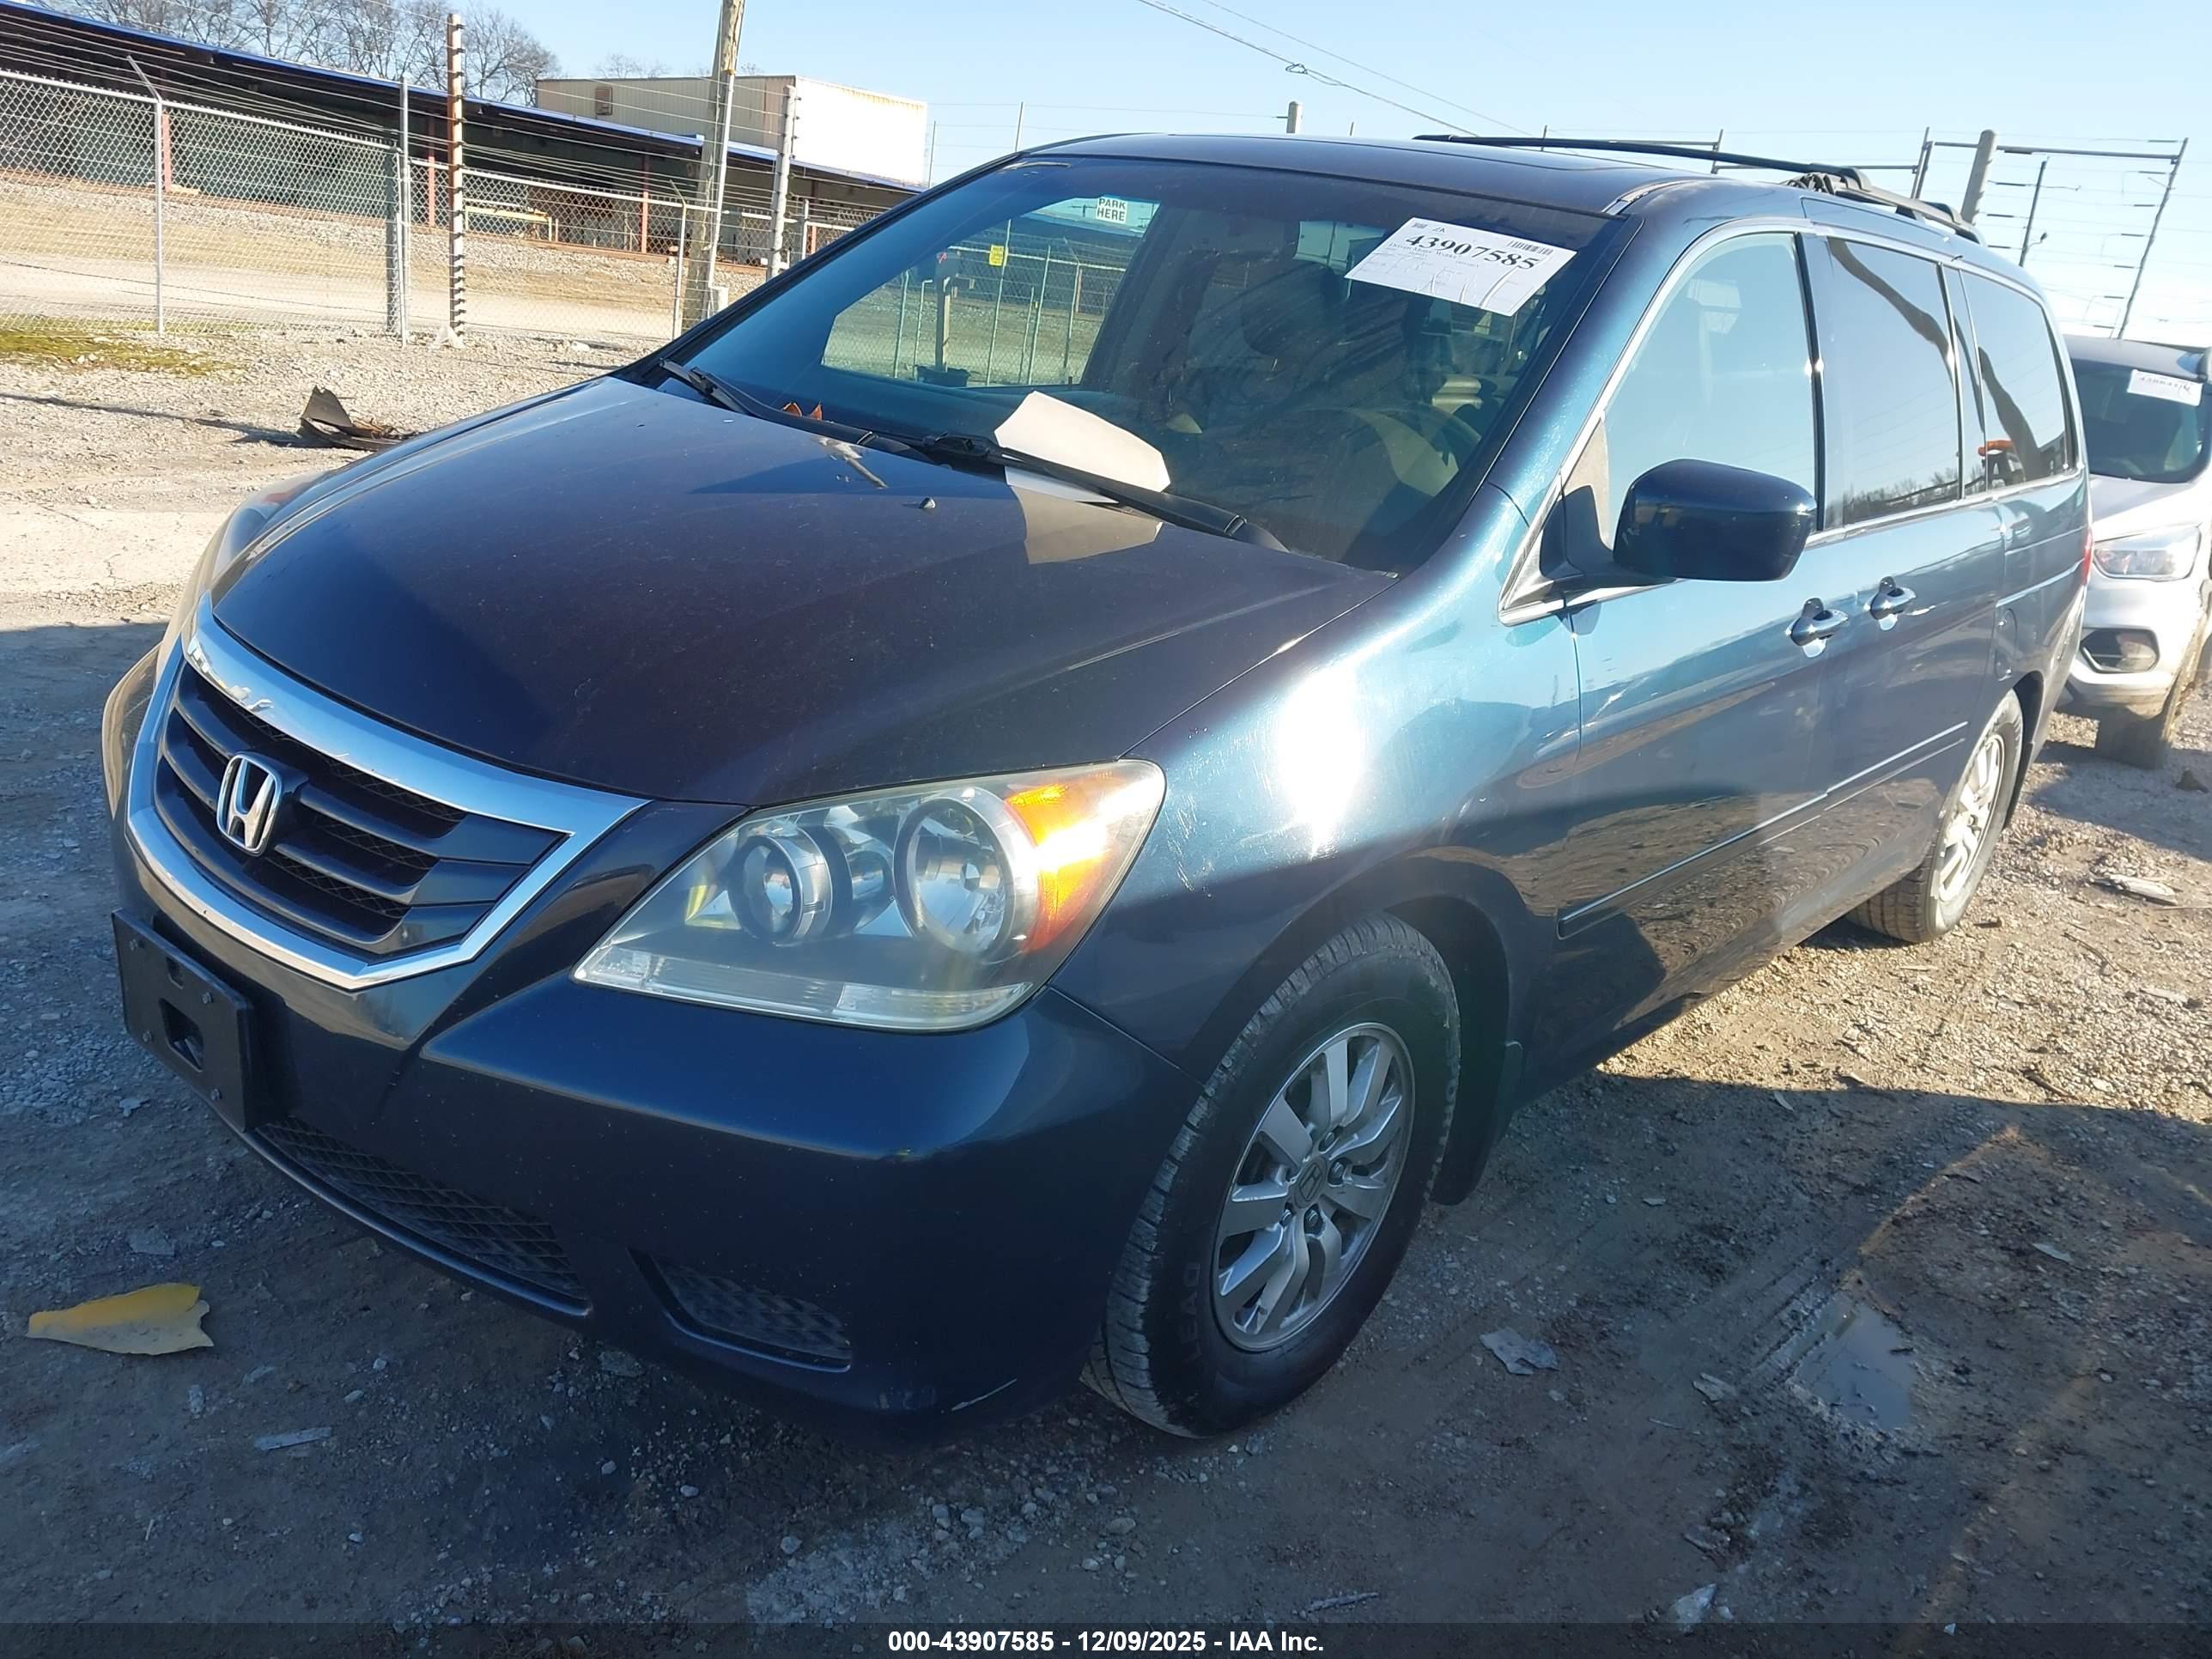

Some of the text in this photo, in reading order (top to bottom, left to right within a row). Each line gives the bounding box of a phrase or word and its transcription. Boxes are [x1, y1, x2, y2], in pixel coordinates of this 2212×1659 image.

[1098, 198, 1126, 210] PARK
[1097, 208, 1125, 222] HERE
[1405, 234, 1540, 270] 43907585
